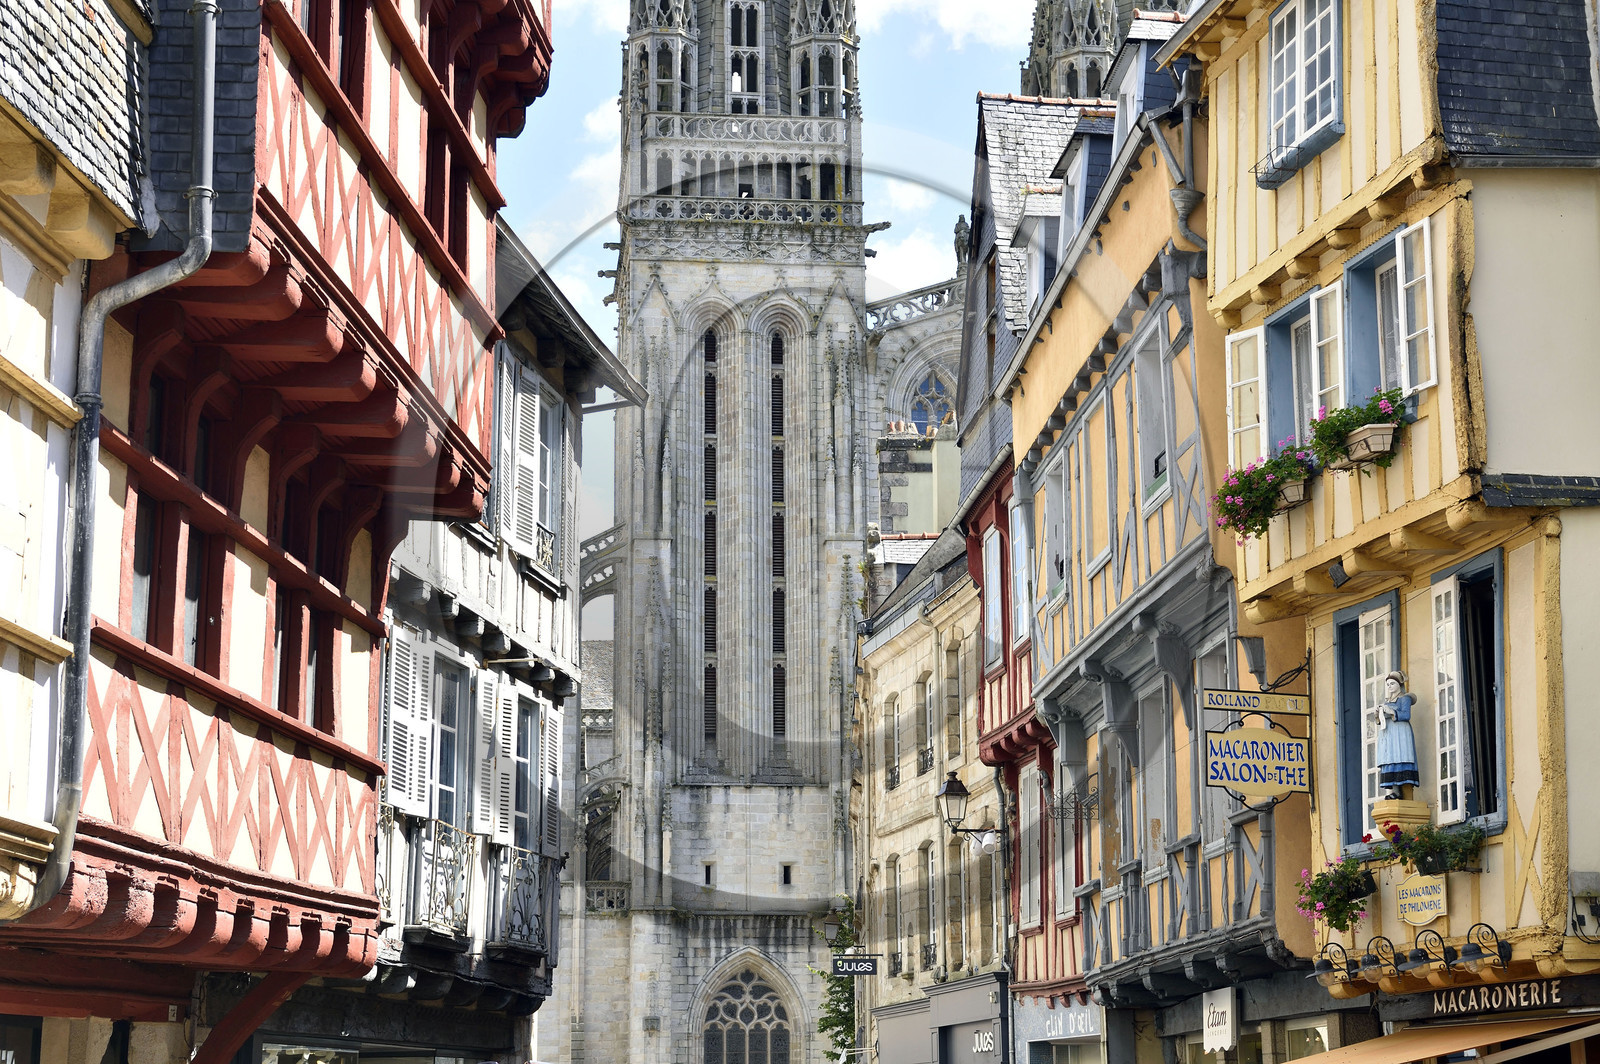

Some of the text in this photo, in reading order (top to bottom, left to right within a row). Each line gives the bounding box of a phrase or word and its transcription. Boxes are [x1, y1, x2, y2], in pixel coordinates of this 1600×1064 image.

[1208, 693, 1260, 708] ROLLAND
[1209, 739, 1305, 762] MACARONIER
[1209, 761, 1267, 783] SALON
[1275, 765, 1306, 787] THE
[1398, 883, 1442, 900] LES MACARONS
[1399, 899, 1442, 914] DE PHILOMENE
[1433, 979, 1562, 1014] MACARONERIE
[1207, 1002, 1227, 1029] Etam
